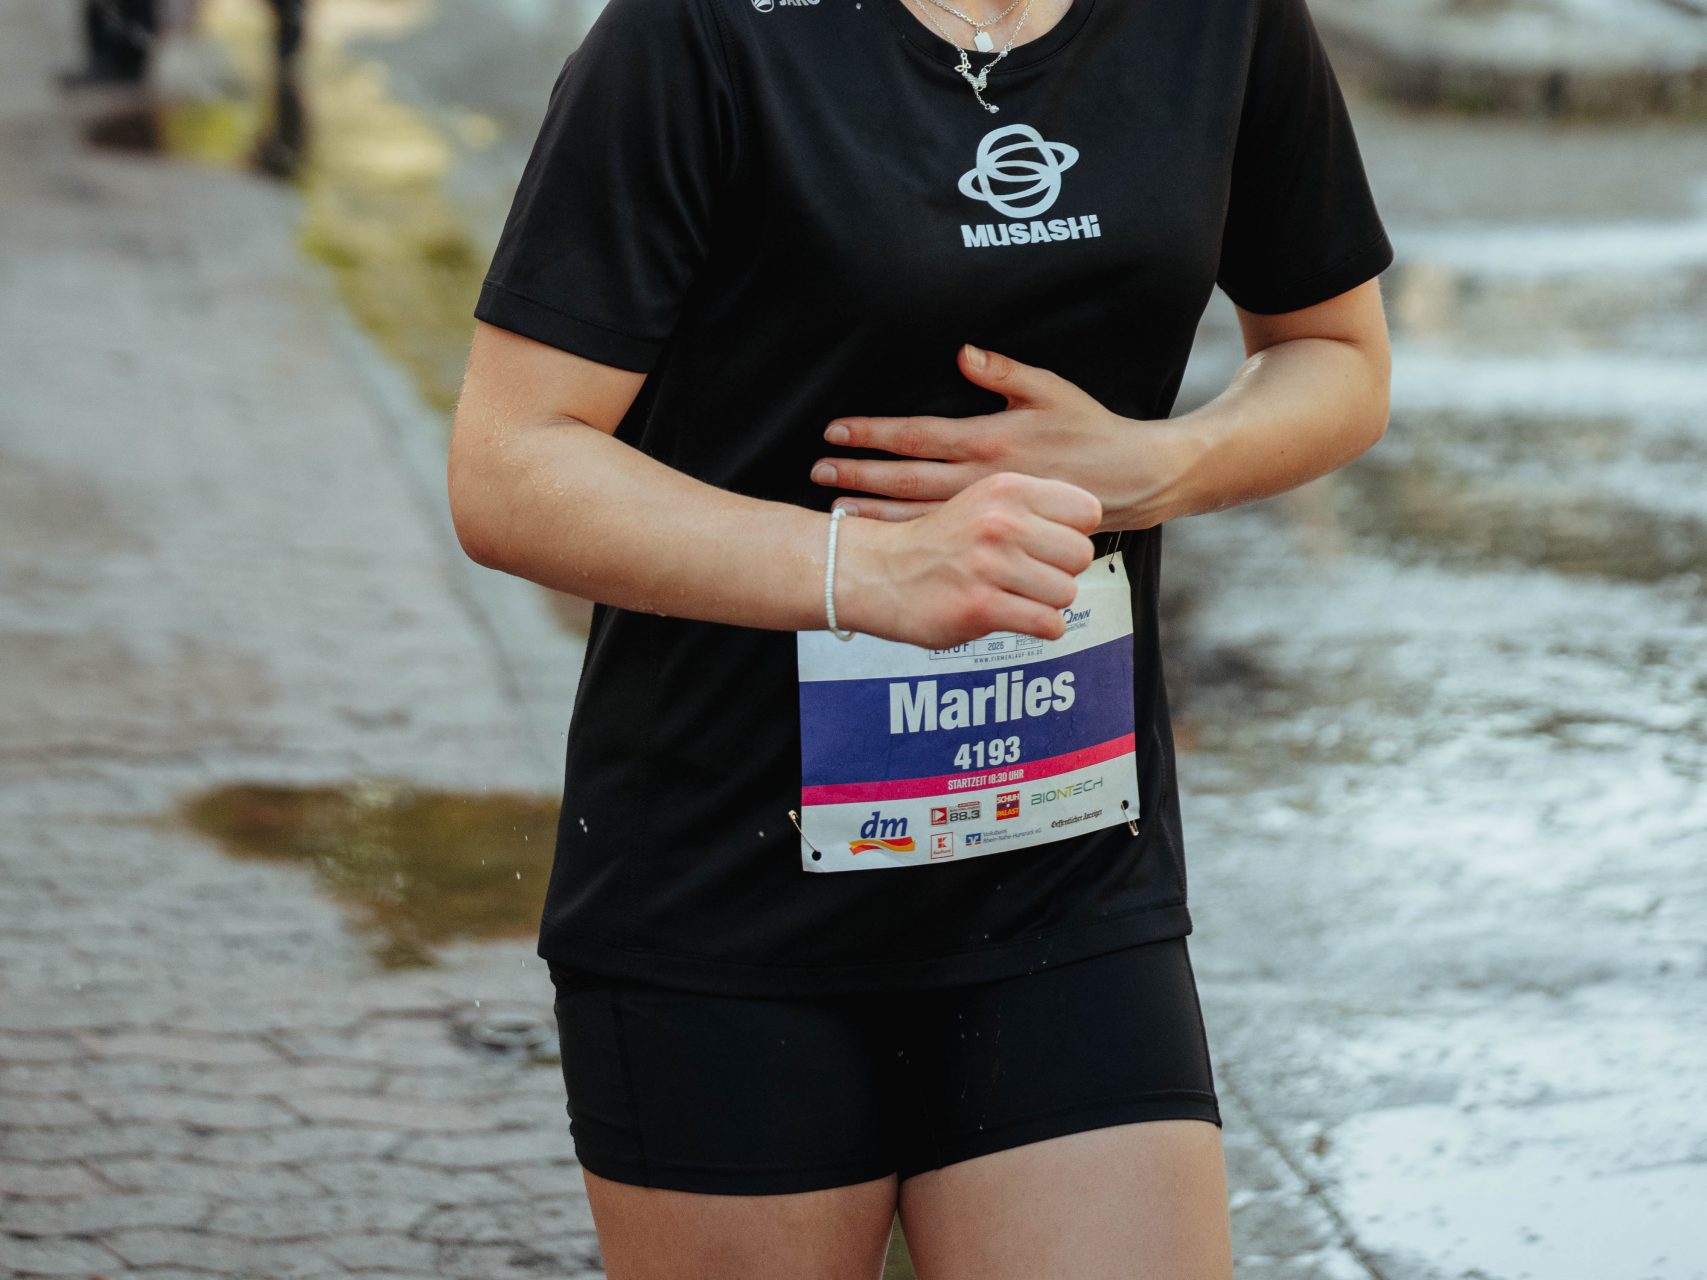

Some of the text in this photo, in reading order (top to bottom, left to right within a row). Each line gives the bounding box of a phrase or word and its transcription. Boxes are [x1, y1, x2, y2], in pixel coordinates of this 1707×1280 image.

[889, 670, 1076, 734] Marlies
[953, 735, 1021, 770] 4193
[947, 769, 1025, 791] STARTZEIT 18:30 UHR
[1031, 776, 1103, 806] BIONTECH
[996, 793, 1020, 804] SCHUH
[860, 811, 908, 839] dm
[949, 809, 981, 822] 88.3
